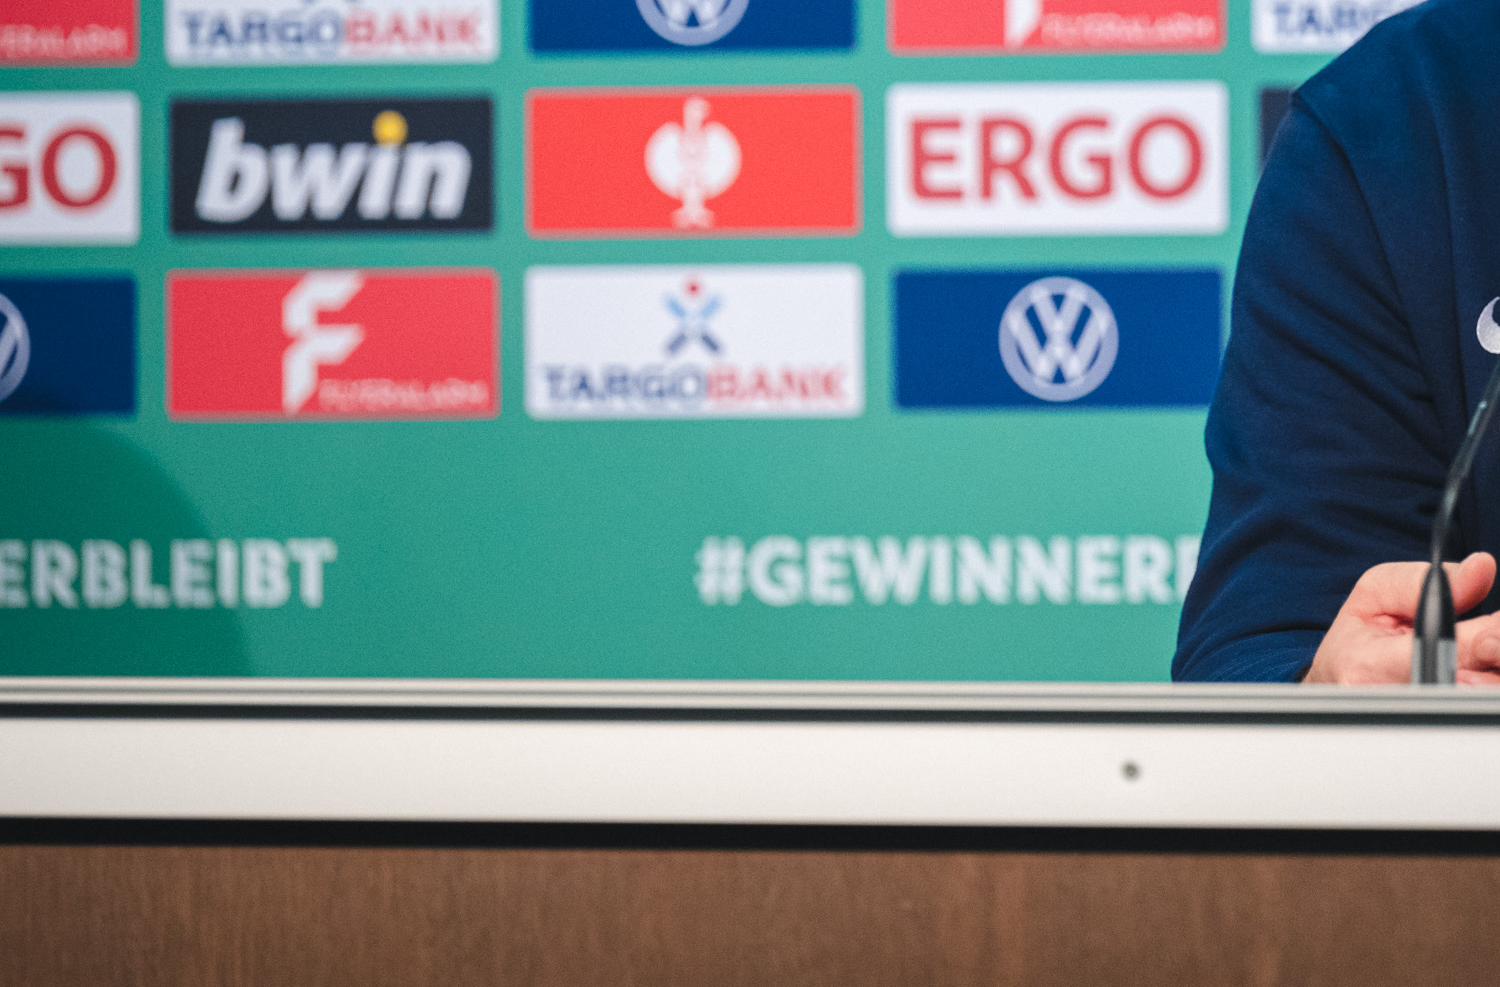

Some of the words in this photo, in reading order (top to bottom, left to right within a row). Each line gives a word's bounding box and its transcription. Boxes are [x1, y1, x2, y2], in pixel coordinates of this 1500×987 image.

[184, 11, 481, 55] TARGOBANK
[197, 112, 471, 221] bwin
[909, 113, 1206, 203] ERGO
[544, 364, 846, 405] TARGOBANK
